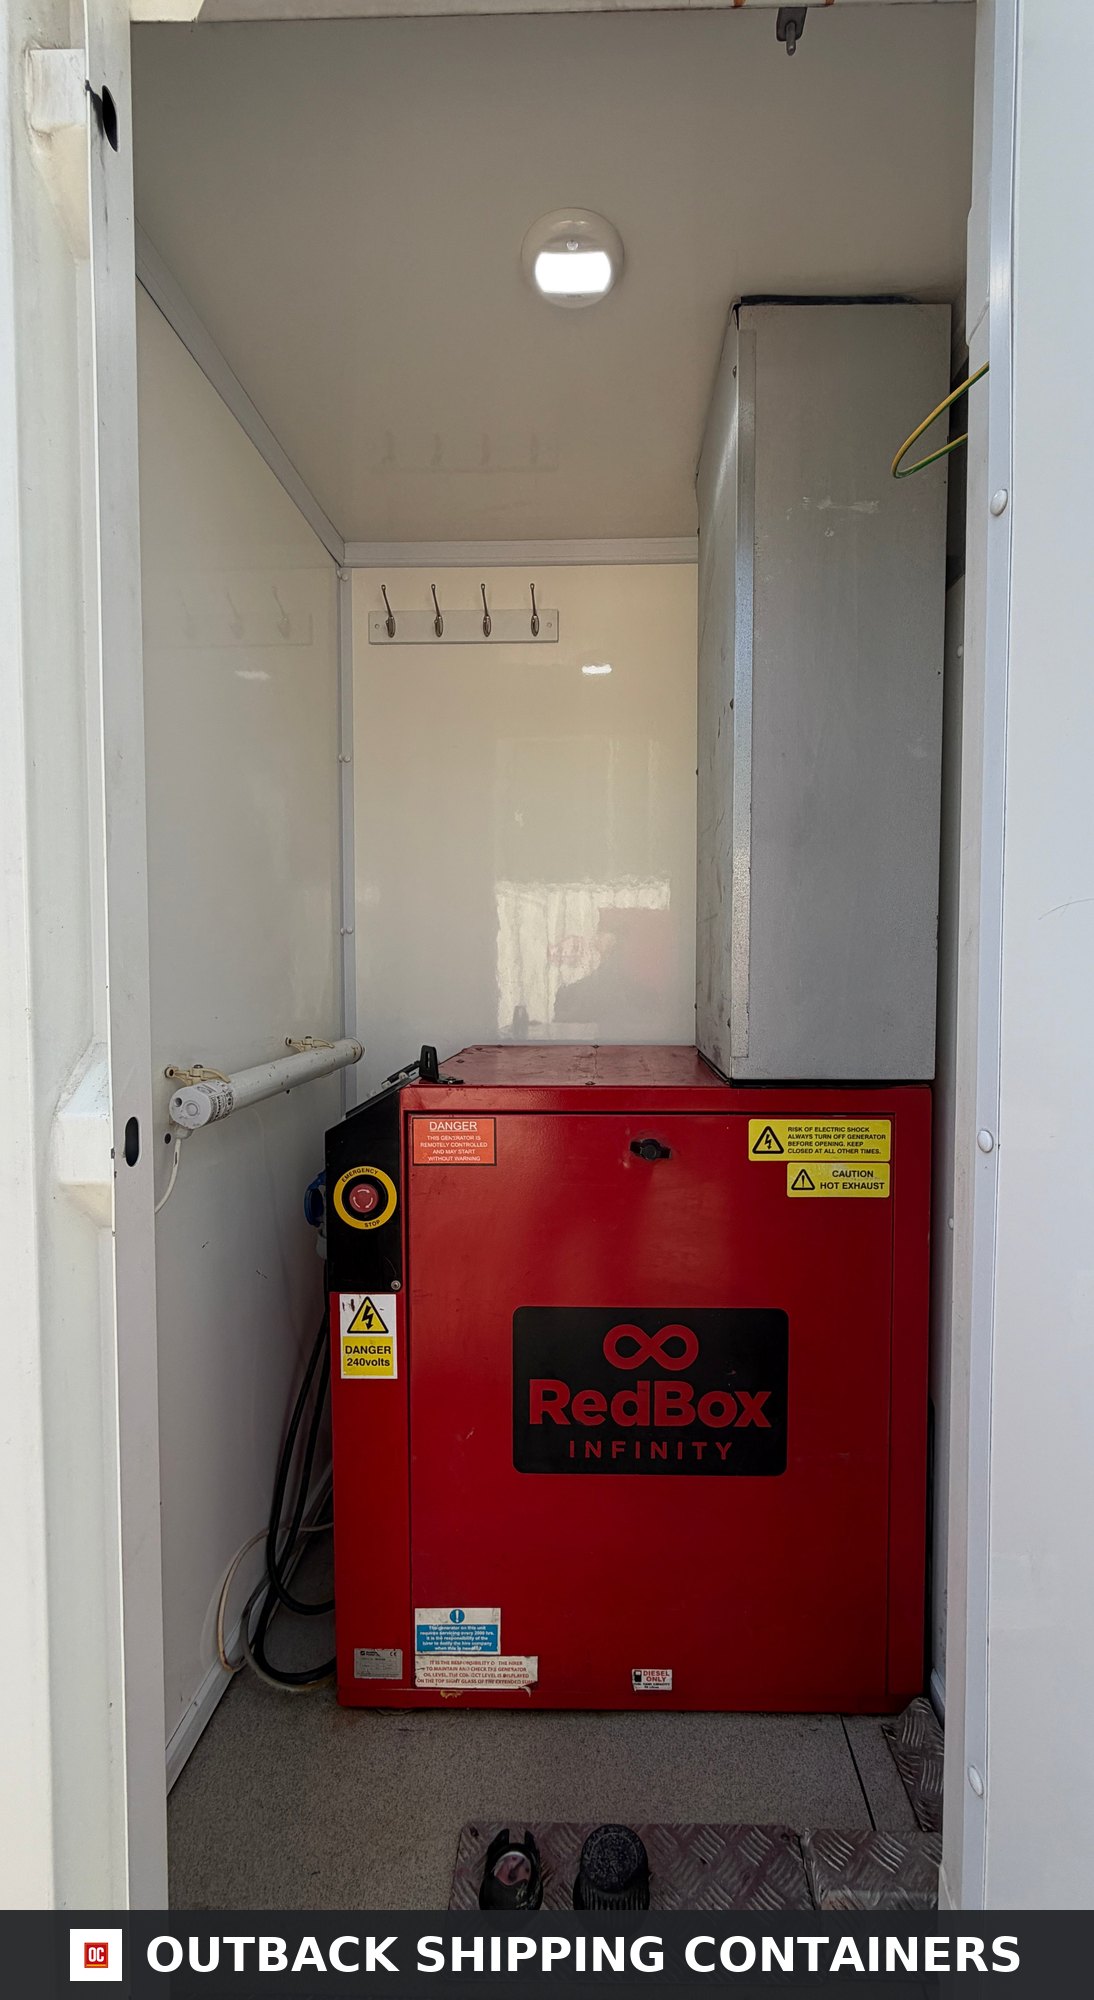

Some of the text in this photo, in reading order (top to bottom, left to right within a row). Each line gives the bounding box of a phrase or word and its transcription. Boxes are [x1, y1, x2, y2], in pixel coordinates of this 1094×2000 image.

[429, 1121, 477, 1131] DANGER
[341, 1167, 378, 1183] EMERGENCY
[832, 1170, 873, 1178] CAUTION
[820, 1182, 885, 1190] HOT EXHAUST
[345, 1345, 391, 1354] DANGER
[346, 1358, 390, 1366] 240volts
[529, 1378, 772, 1428] RedBox
[569, 1440, 733, 1460] INFINITY
